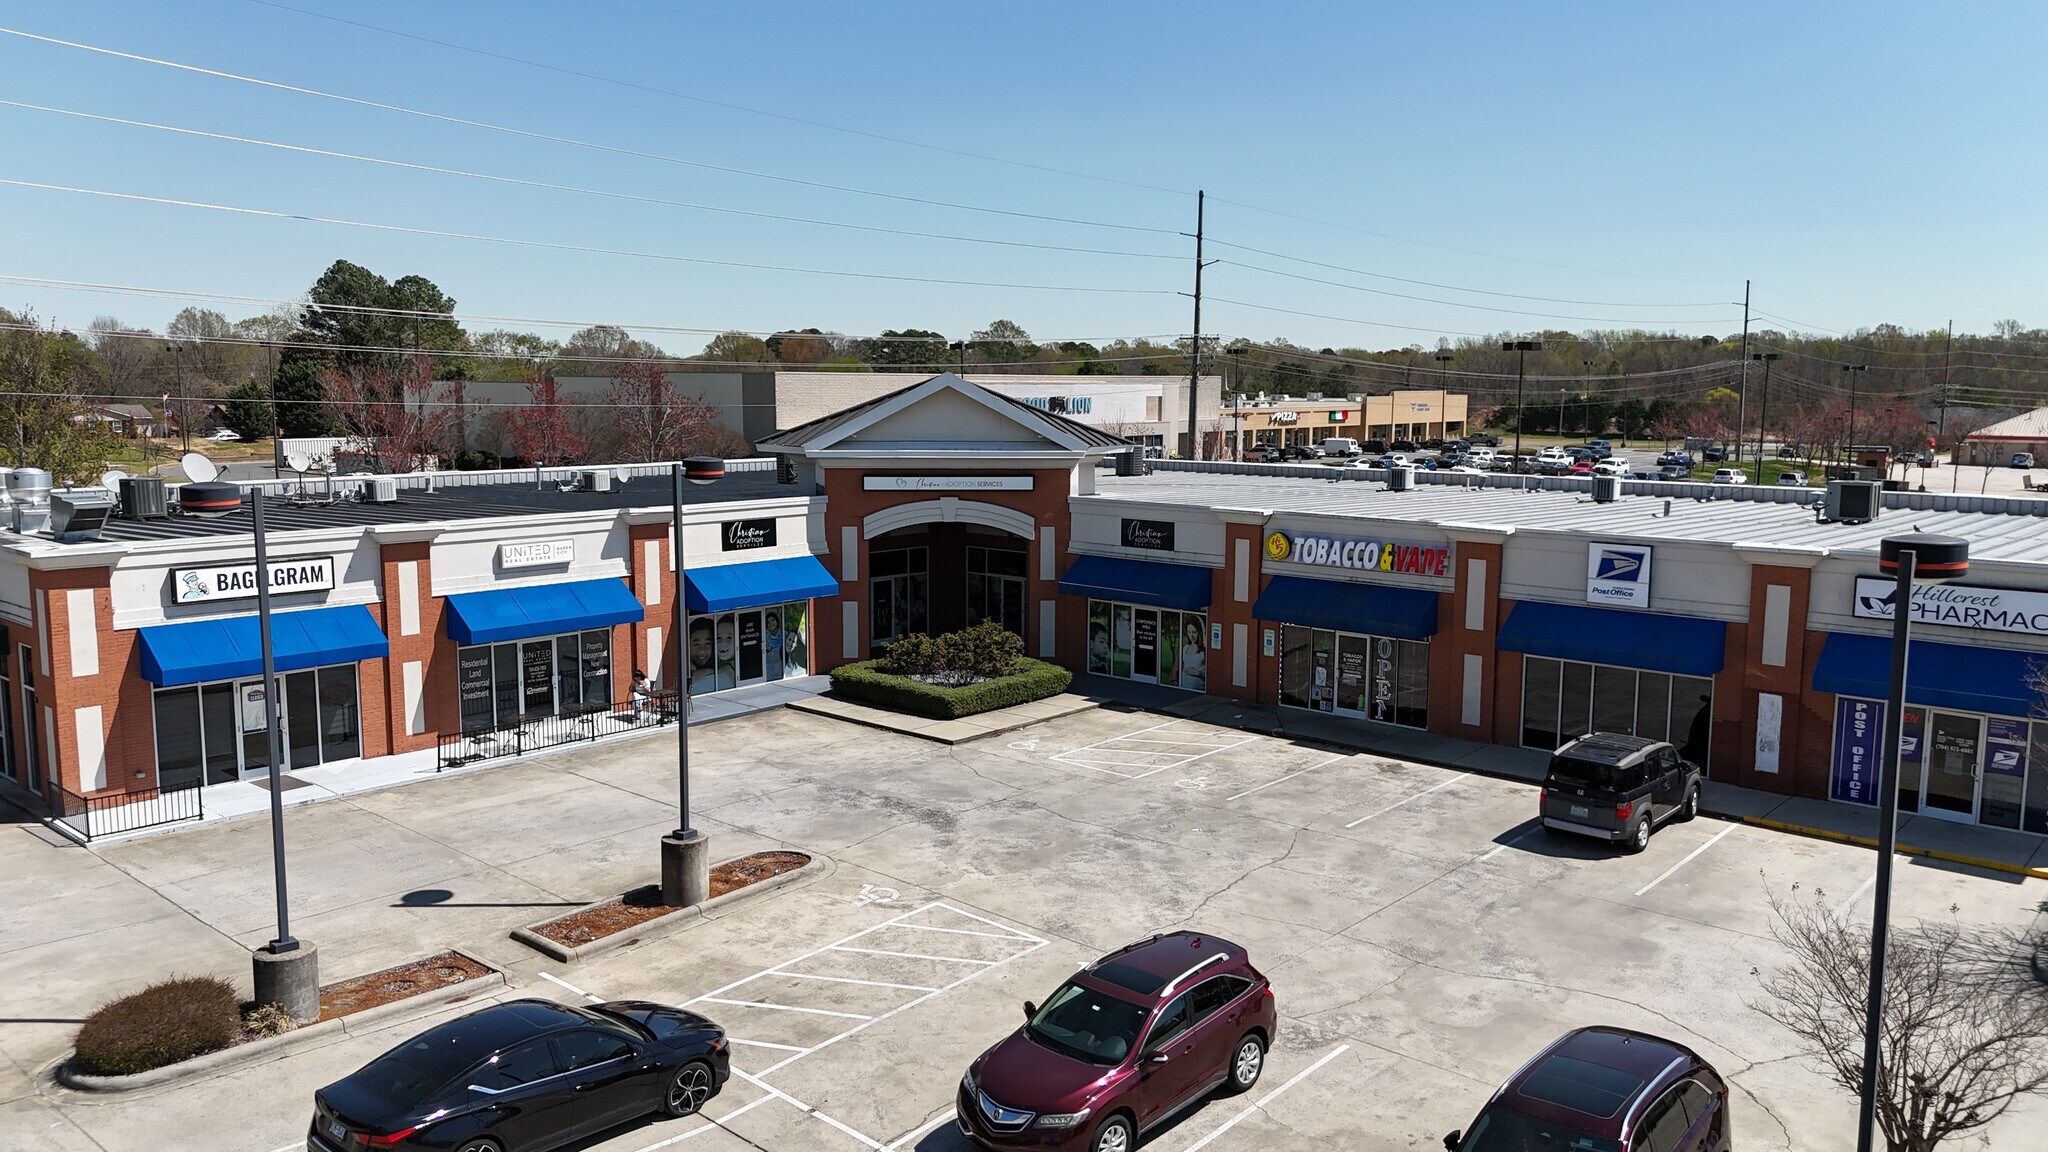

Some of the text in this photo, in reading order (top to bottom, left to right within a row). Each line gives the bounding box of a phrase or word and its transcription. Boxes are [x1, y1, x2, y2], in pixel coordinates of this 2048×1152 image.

[1066, 397, 1092, 414] LION
[1276, 411, 1297, 421] PIZZA
[728, 521, 770, 544] Christian
[1128, 520, 1168, 541] Christian
[736, 537, 764, 545] ADOPTION
[1293, 537, 1449, 576] TOBACCO & VAPE
[1592, 586, 1610, 595] Post
[1610, 588, 1634, 598] Office
[1911, 585, 2001, 608] Hillcrest
[462, 657, 488, 669] Residential
[469, 669, 481, 678] Land
[462, 678, 489, 690] Commercial
[463, 689, 489, 700] Investment
[1854, 702, 1867, 737] POST
[1849, 746, 1864, 799] OFFICE
